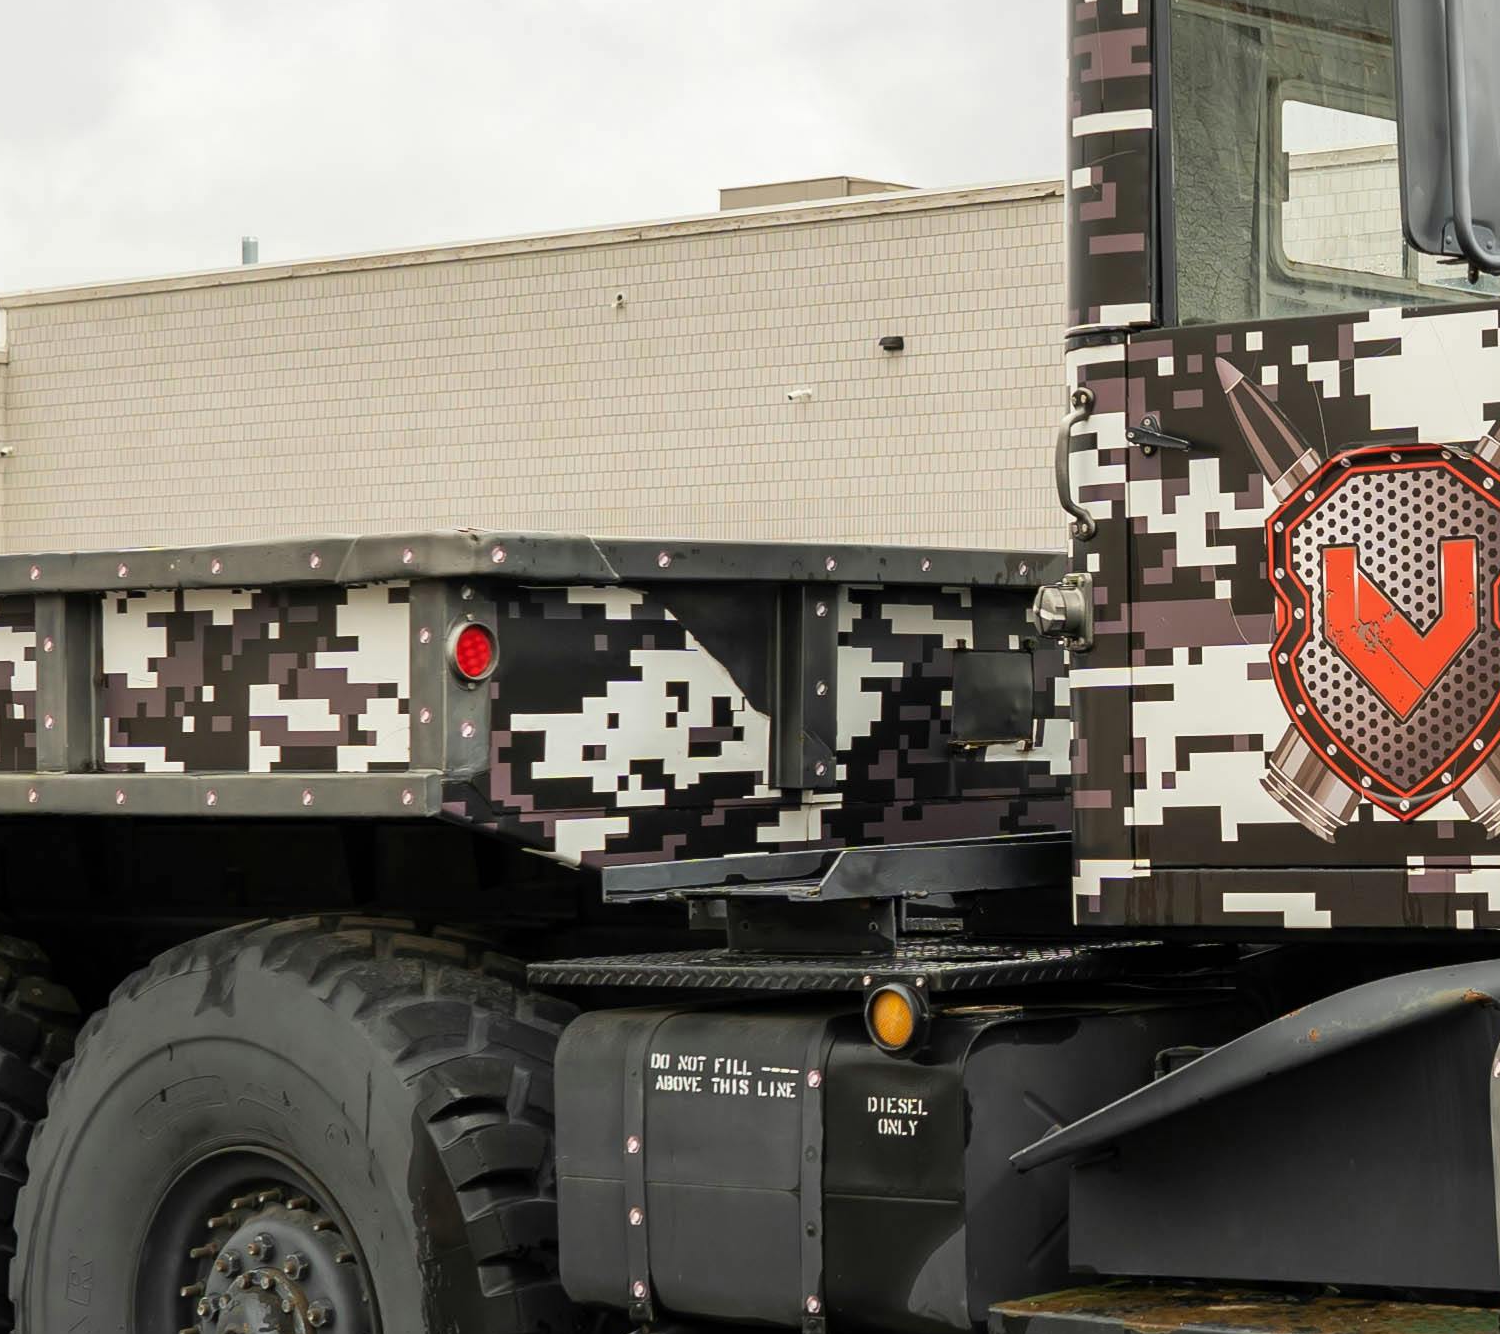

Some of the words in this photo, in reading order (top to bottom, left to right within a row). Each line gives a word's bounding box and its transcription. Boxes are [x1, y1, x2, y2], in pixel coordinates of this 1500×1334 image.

[650, 1053, 670, 1069] DO
[678, 1055, 707, 1072] NOT
[714, 1057, 752, 1076] FILL
[655, 1075, 702, 1092] ABOVE
[711, 1077, 749, 1095] THIS
[757, 1080, 796, 1098] LINE
[867, 1096, 928, 1115] DIESEL
[878, 1118, 918, 1136] ONLY
